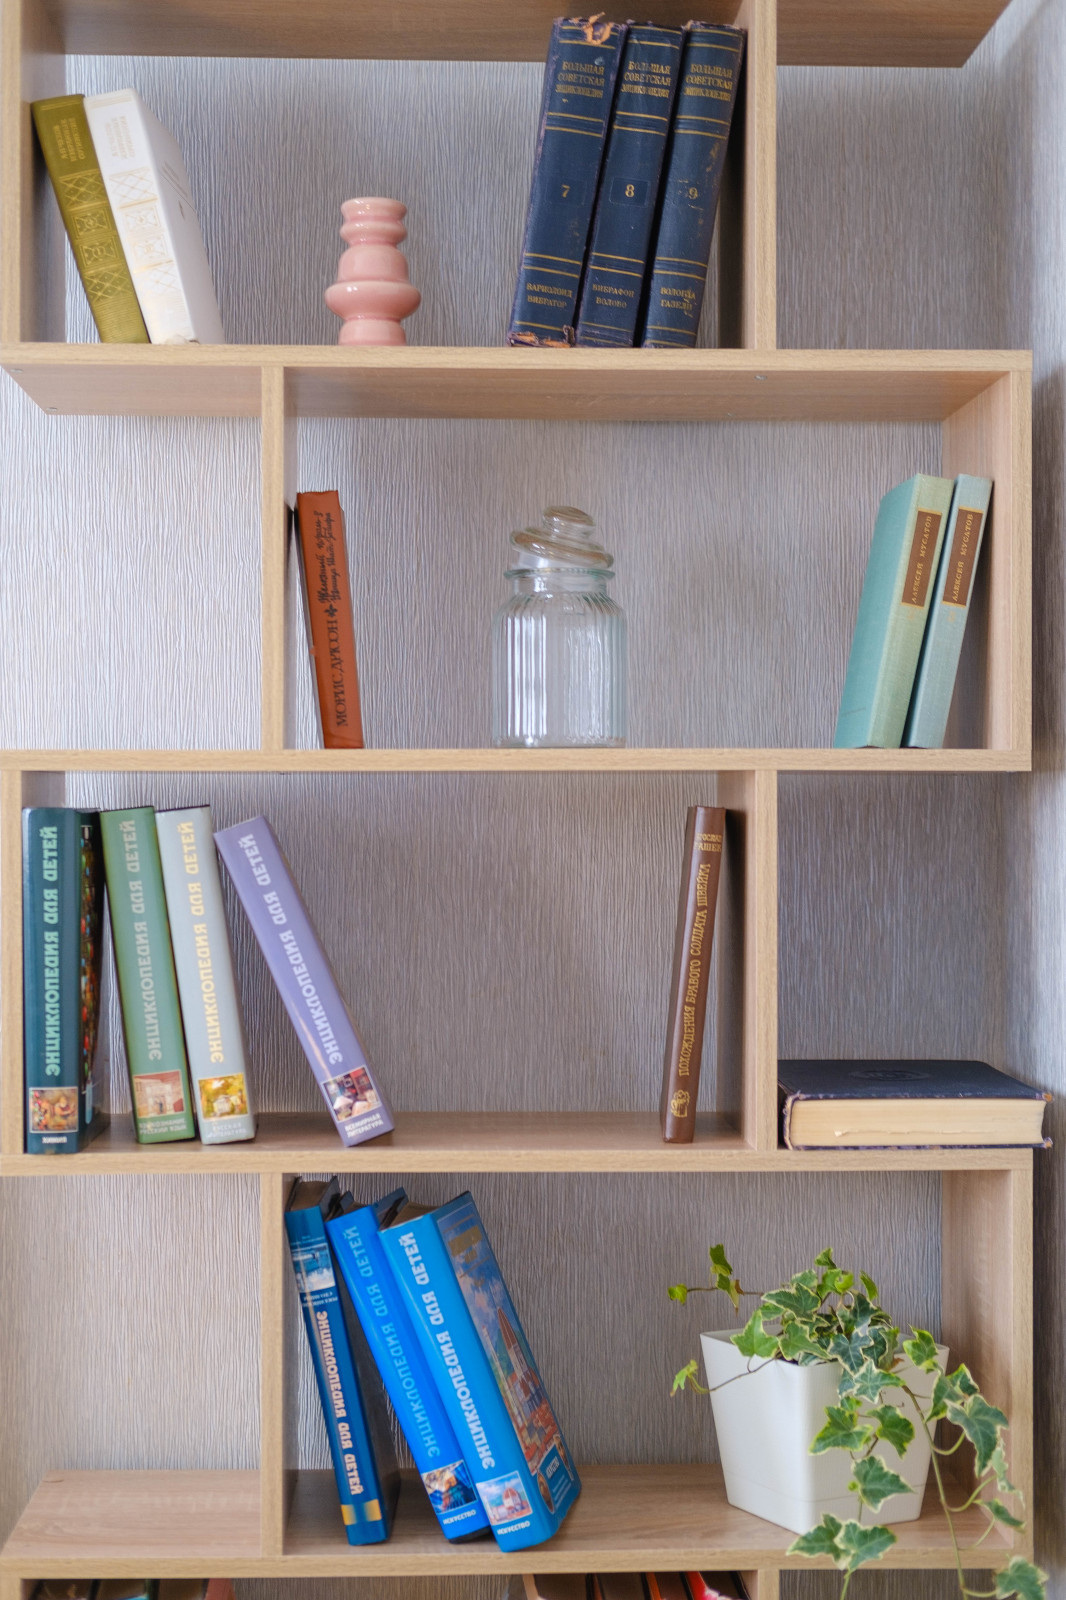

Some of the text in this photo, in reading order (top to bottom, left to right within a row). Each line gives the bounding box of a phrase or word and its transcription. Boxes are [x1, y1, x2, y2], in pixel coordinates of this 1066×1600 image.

[557, 73, 605, 86] СОВЕТСКАЯ
[562, 61, 605, 75] БОЛЬШАЯ
[623, 73, 671, 86] СОВЕТСКАЯ
[627, 61, 671, 74] БОЛЬШАЯ
[690, 64, 733, 77] БОЛЬШАЯ
[685, 75, 733, 89] СОВЕТСКАЯ
[561, 184, 570, 198] 7
[625, 184, 634, 198] 8
[689, 187, 699, 200] 9
[527, 295, 568, 308] ВИБРАТОР
[592, 283, 635, 299] ВИБРАФОН
[596, 297, 628, 308] ВОЛОВО
[911, 563, 924, 604] АЛЕКСЕЙ
[920, 515, 932, 558] МУСАТОВ
[952, 561, 965, 602] АЛЕКСЕЙ
[961, 513, 974, 555] МУСАТОВ
[327, 619, 348, 728] МОРИС ДРЮОН
[40, 825, 60, 1077] ЭНЦИКЛОПЕДИЯ ДЛЯ ДЕТЕЙ
[120, 820, 163, 1062] ЭНЦИКЛОПЕДИЯ ДЛЯ ДЕТЕЙ
[178, 821, 225, 1065] ЭНЦИКЛОПЕДИЯ ДЛЯ ДЕТЕЙ
[237, 833, 343, 1066] ЭНЦИКЛОПЕДИЯ ДЛЯ ДЕТЕЙ
[678, 863, 711, 1077] ПОХОЖДЕНИЯ БРАВОГО СОЛДАТА ШВЕЙКА
[341, 1225, 440, 1458] ЭНЦИКЛОПЕДИЯ ДЛЯ ДЕТЕЙ
[398, 1232, 495, 1470] ЭНЦИКЛОПЕДИЯ ДЛЯ ДЕТЕЙ
[316, 1310, 347, 1418] ЭНЦИКЛОПЕДИЯ
[337, 1422, 352, 1448] ДЛЯ
[344, 1452, 364, 1496] ДЕТЕЙ
